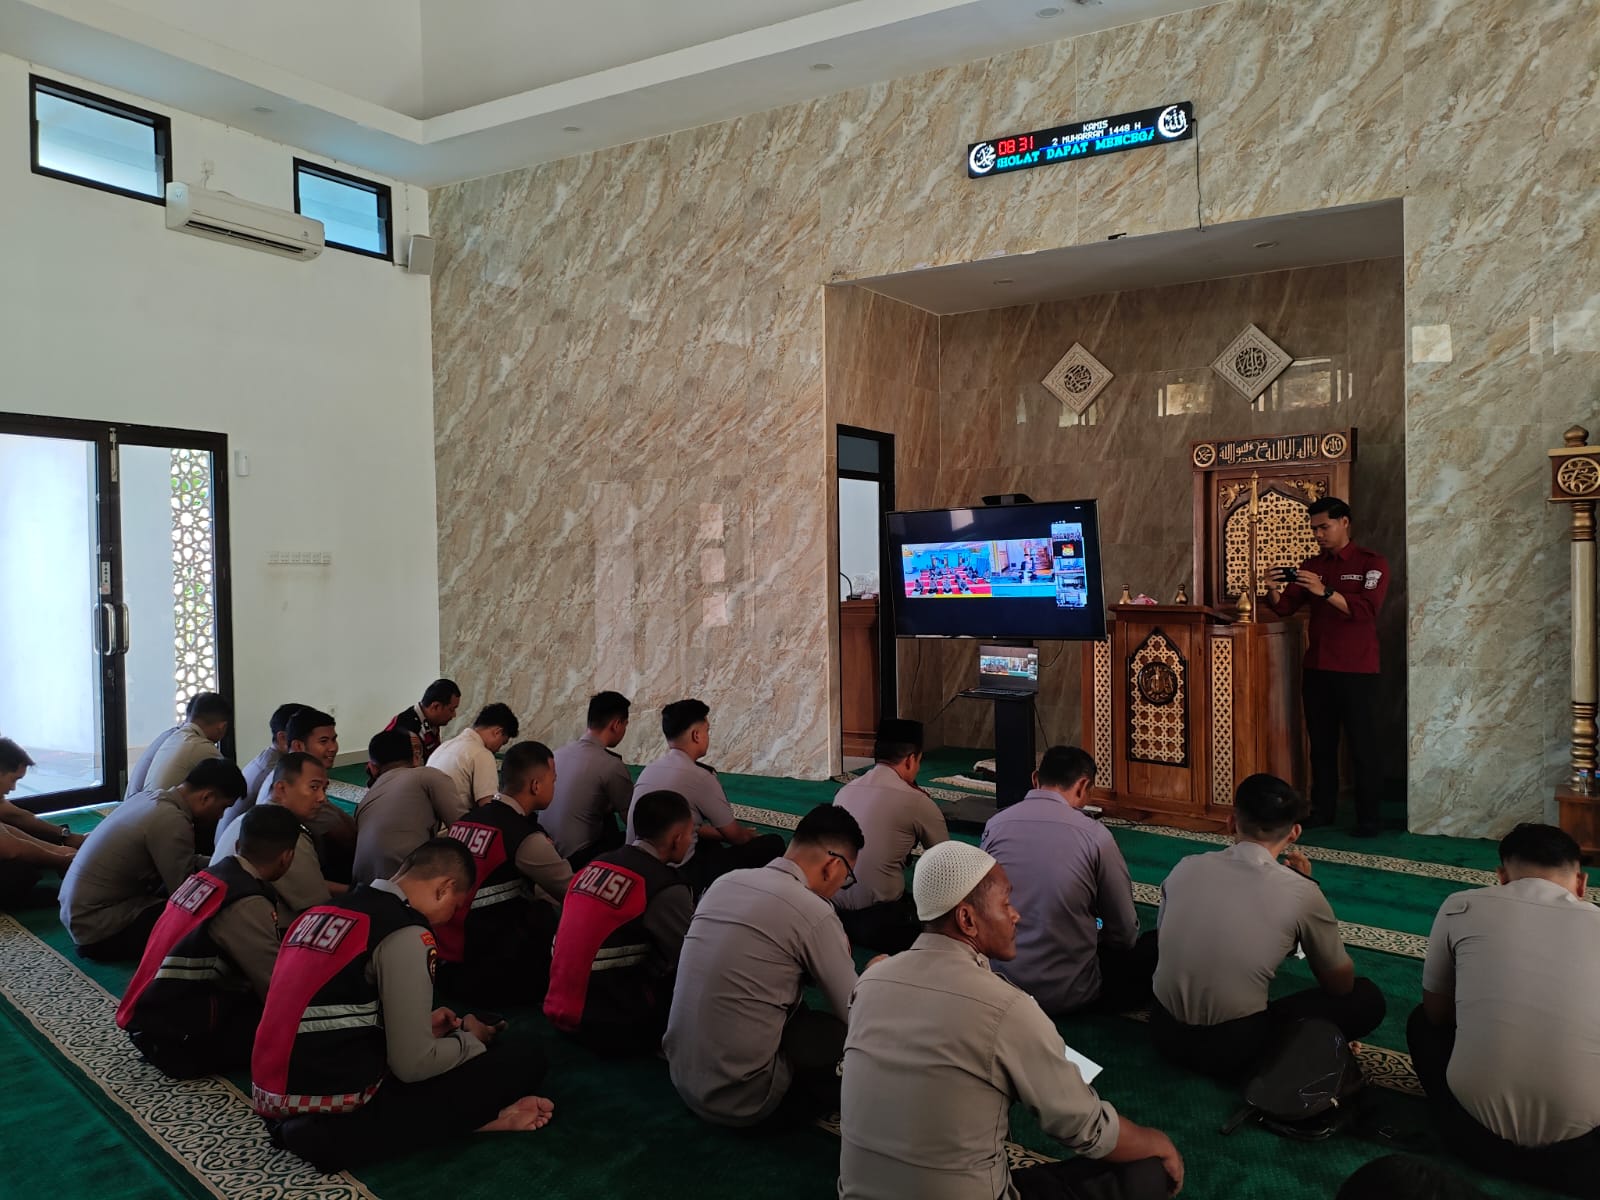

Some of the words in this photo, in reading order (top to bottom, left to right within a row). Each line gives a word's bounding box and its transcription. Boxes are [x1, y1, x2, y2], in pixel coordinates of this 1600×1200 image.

[1051, 137, 1059, 147] 2
[1061, 129, 1104, 145] MUHARRAM
[1109, 123, 1130, 135] 1448
[1134, 121, 1142, 131] H
[1083, 120, 1109, 132] KAMIS
[1046, 141, 1089, 160] DAPAT
[448, 825, 492, 855] POLISI
[572, 865, 632, 905] POLISI
[288, 914, 353, 950] POLISI
